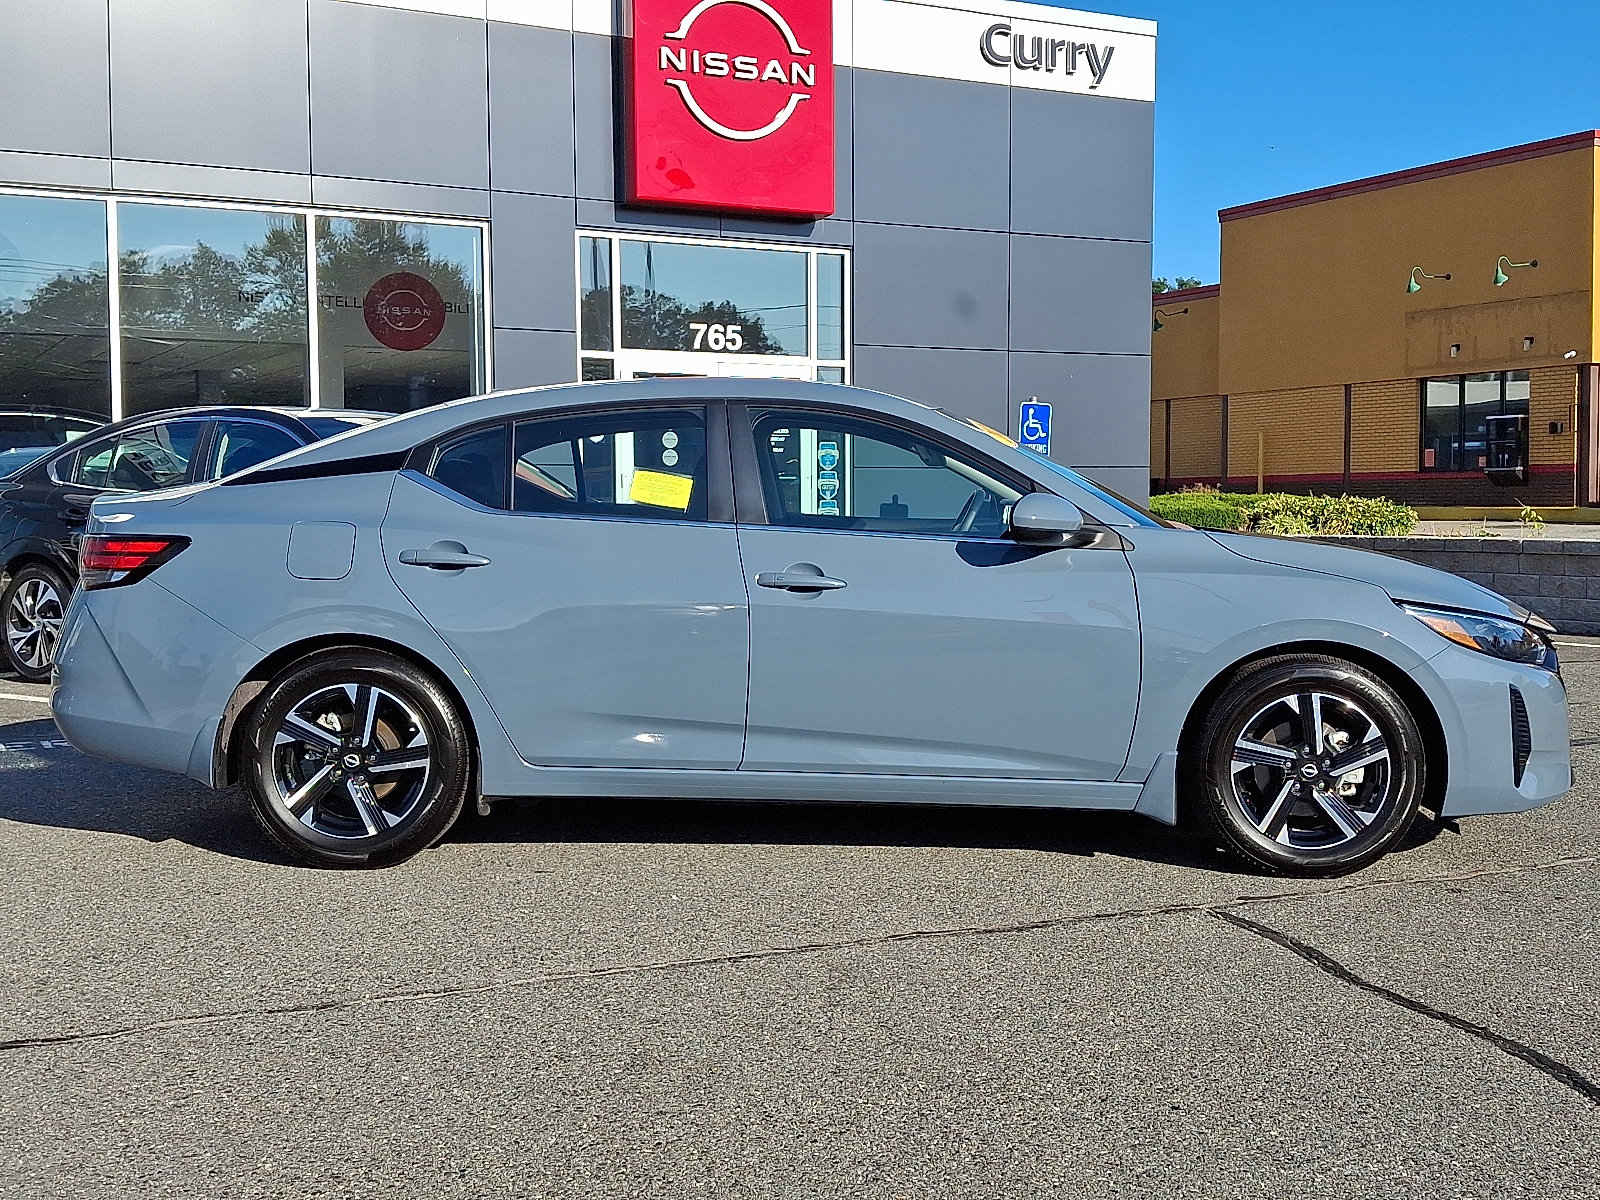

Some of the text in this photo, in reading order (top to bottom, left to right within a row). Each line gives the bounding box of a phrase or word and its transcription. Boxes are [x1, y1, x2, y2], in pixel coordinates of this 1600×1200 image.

[659, 45, 815, 87] NISSAN
[980, 23, 1115, 89] Curry
[377, 305, 432, 317] NISSAN
[689, 322, 743, 351] 765
